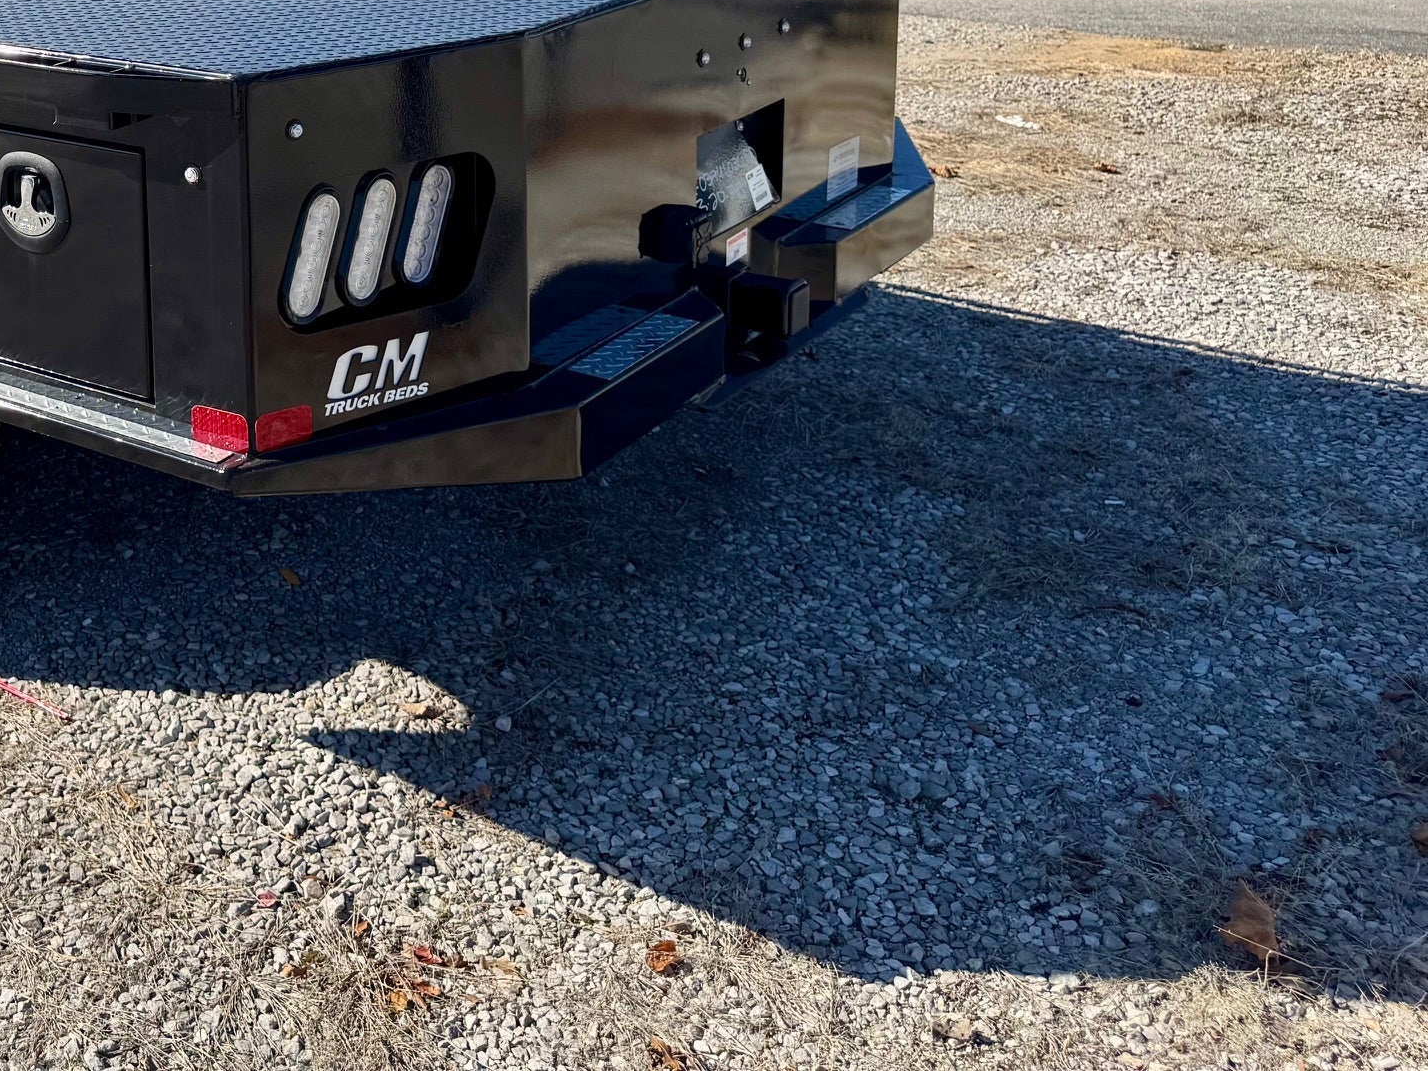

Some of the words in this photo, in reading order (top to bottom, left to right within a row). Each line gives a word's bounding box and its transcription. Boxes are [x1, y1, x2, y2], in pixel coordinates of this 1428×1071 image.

[326, 330, 430, 400] CM
[324, 392, 381, 417] TRUCK
[383, 382, 430, 404] BEDS
